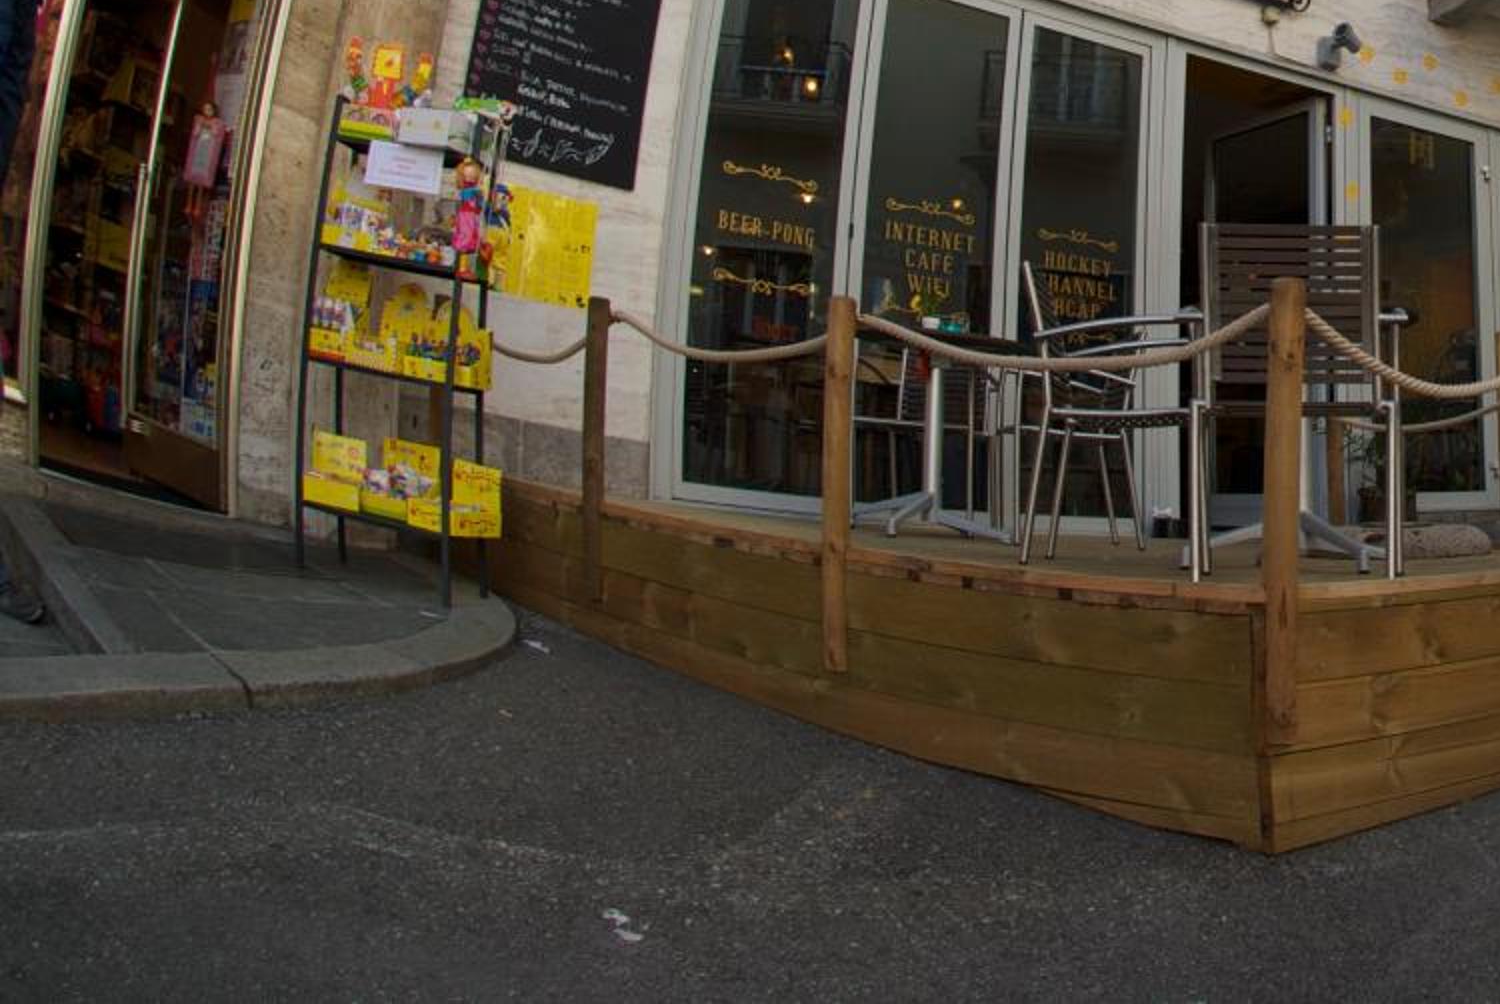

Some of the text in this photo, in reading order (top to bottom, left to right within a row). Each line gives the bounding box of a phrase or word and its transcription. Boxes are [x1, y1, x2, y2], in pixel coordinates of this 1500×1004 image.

[885, 219, 975, 254] INTERNET
[1044, 249, 1113, 276] HOCKEY
[1047, 275, 1118, 302] HANNEL
